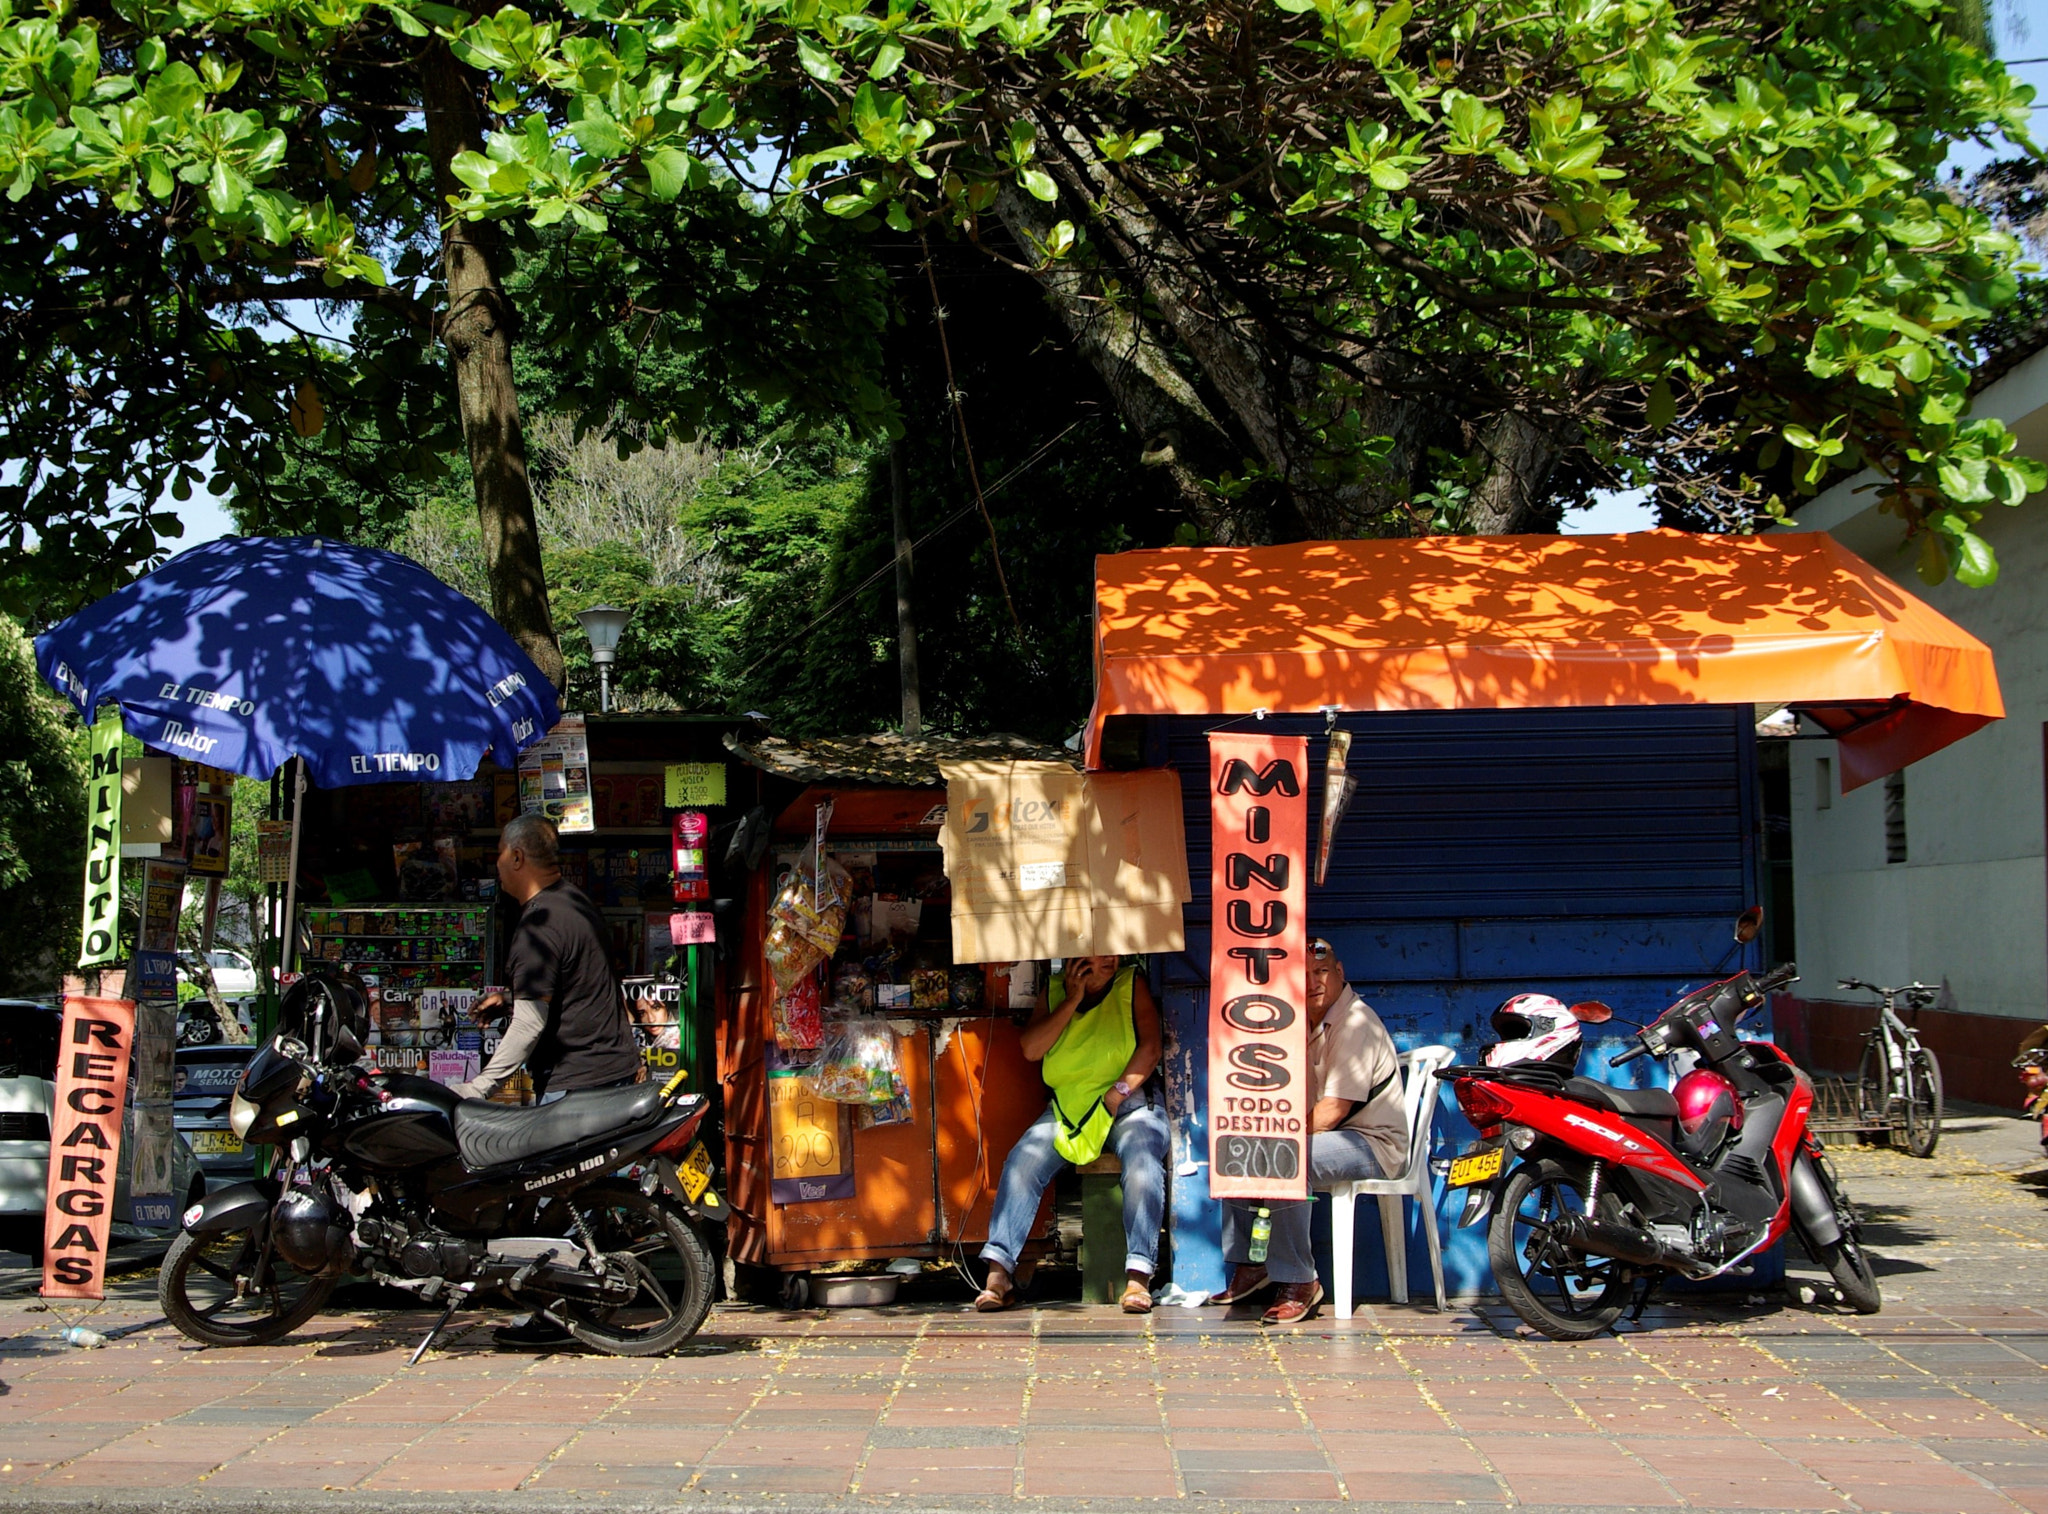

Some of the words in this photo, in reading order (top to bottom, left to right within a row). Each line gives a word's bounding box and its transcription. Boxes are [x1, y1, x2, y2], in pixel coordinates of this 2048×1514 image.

[159, 682, 180, 701] EL
[186, 687, 255, 716] TIEMPO
[485, 689, 501, 708] EL
[494, 671, 527, 702] TIEMPO
[161, 719, 218, 754] Motor
[512, 716, 534, 744] Motor
[350, 755, 372, 774] EL
[373, 753, 440, 772] TIEMPO
[86, 747, 120, 956] MINUTO
[1217, 758, 1300, 1092] MINUTOS
[621, 984, 679, 1001] VOGUE
[1223, 1097, 1292, 1113] TODO
[1216, 1115, 1300, 1133] DESTINO
[50, 1018, 124, 1285] RECARGAS
[776, 1133, 834, 1173] 200
[524, 1168, 577, 1192] Galaxy
[579, 1154, 605, 1172] 100
[136, 1205, 145, 1221] EL
[144, 1204, 171, 1220] TIEMPO
